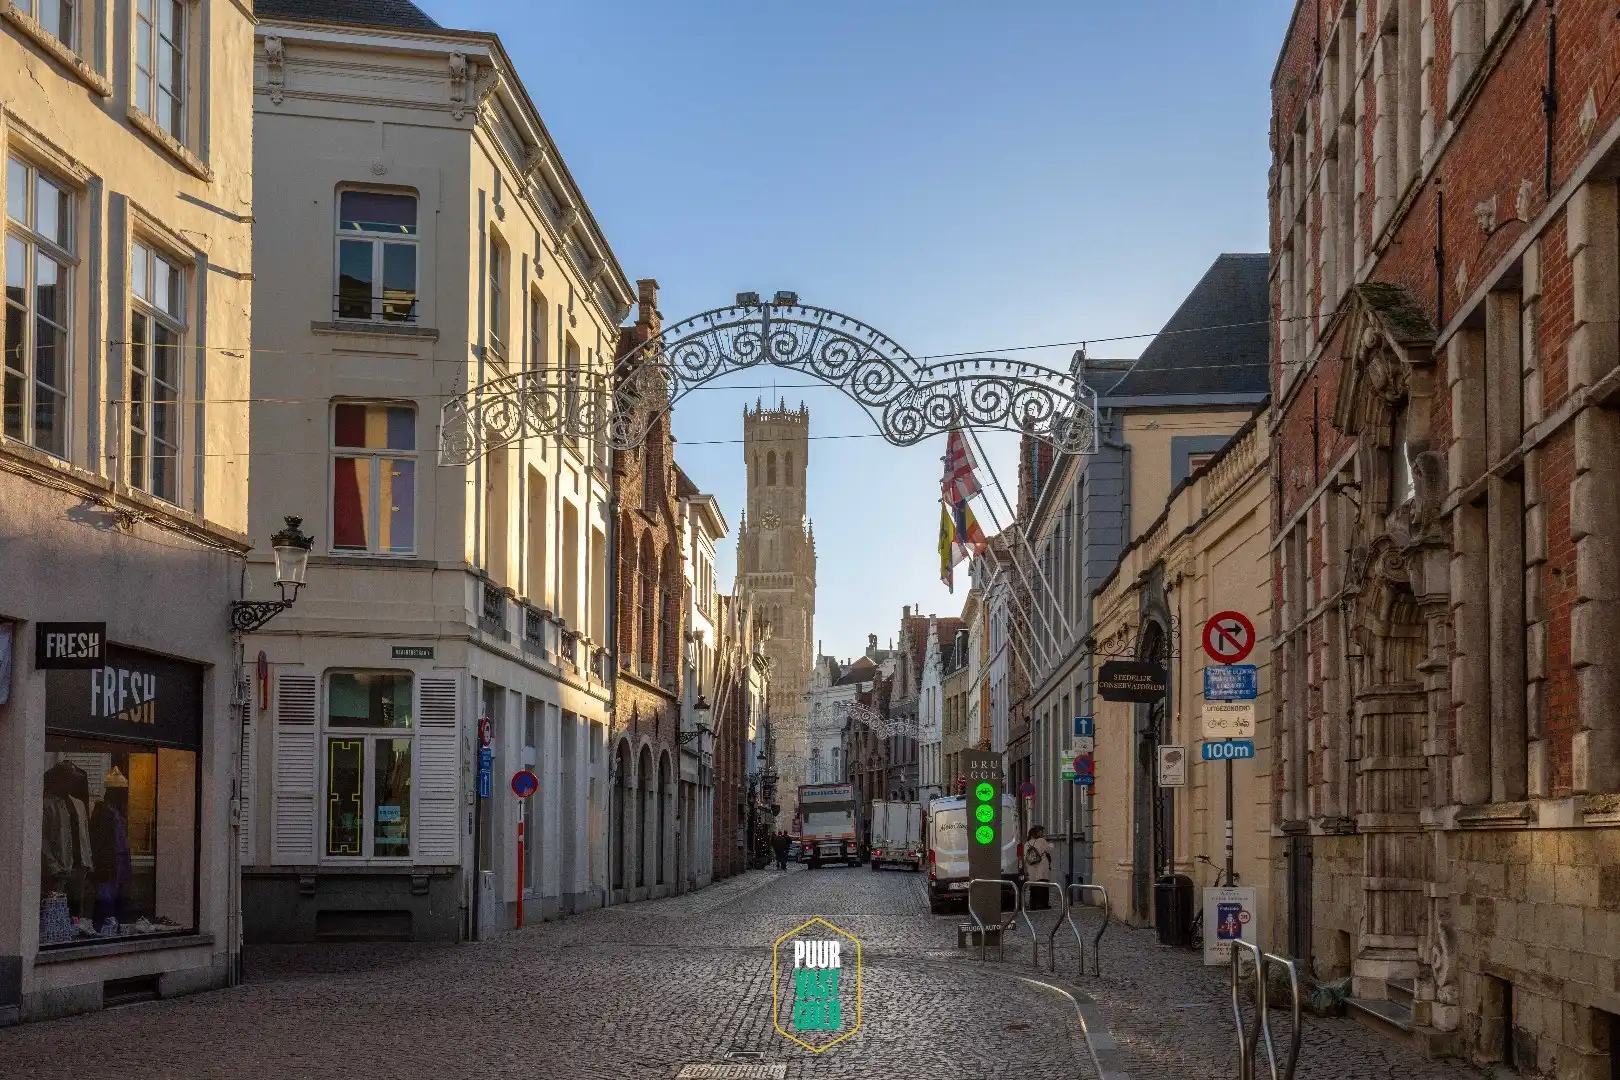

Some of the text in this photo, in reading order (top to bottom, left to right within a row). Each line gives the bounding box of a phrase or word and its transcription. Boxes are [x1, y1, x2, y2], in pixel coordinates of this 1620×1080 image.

[46, 632, 99, 658] FRESH
[1113, 673, 1152, 682] STEDELIJK
[1099, 681, 1165, 690] CONSERVATORIUM
[91, 665, 155, 724] FRESH
[1207, 743, 1249, 758] 100m
